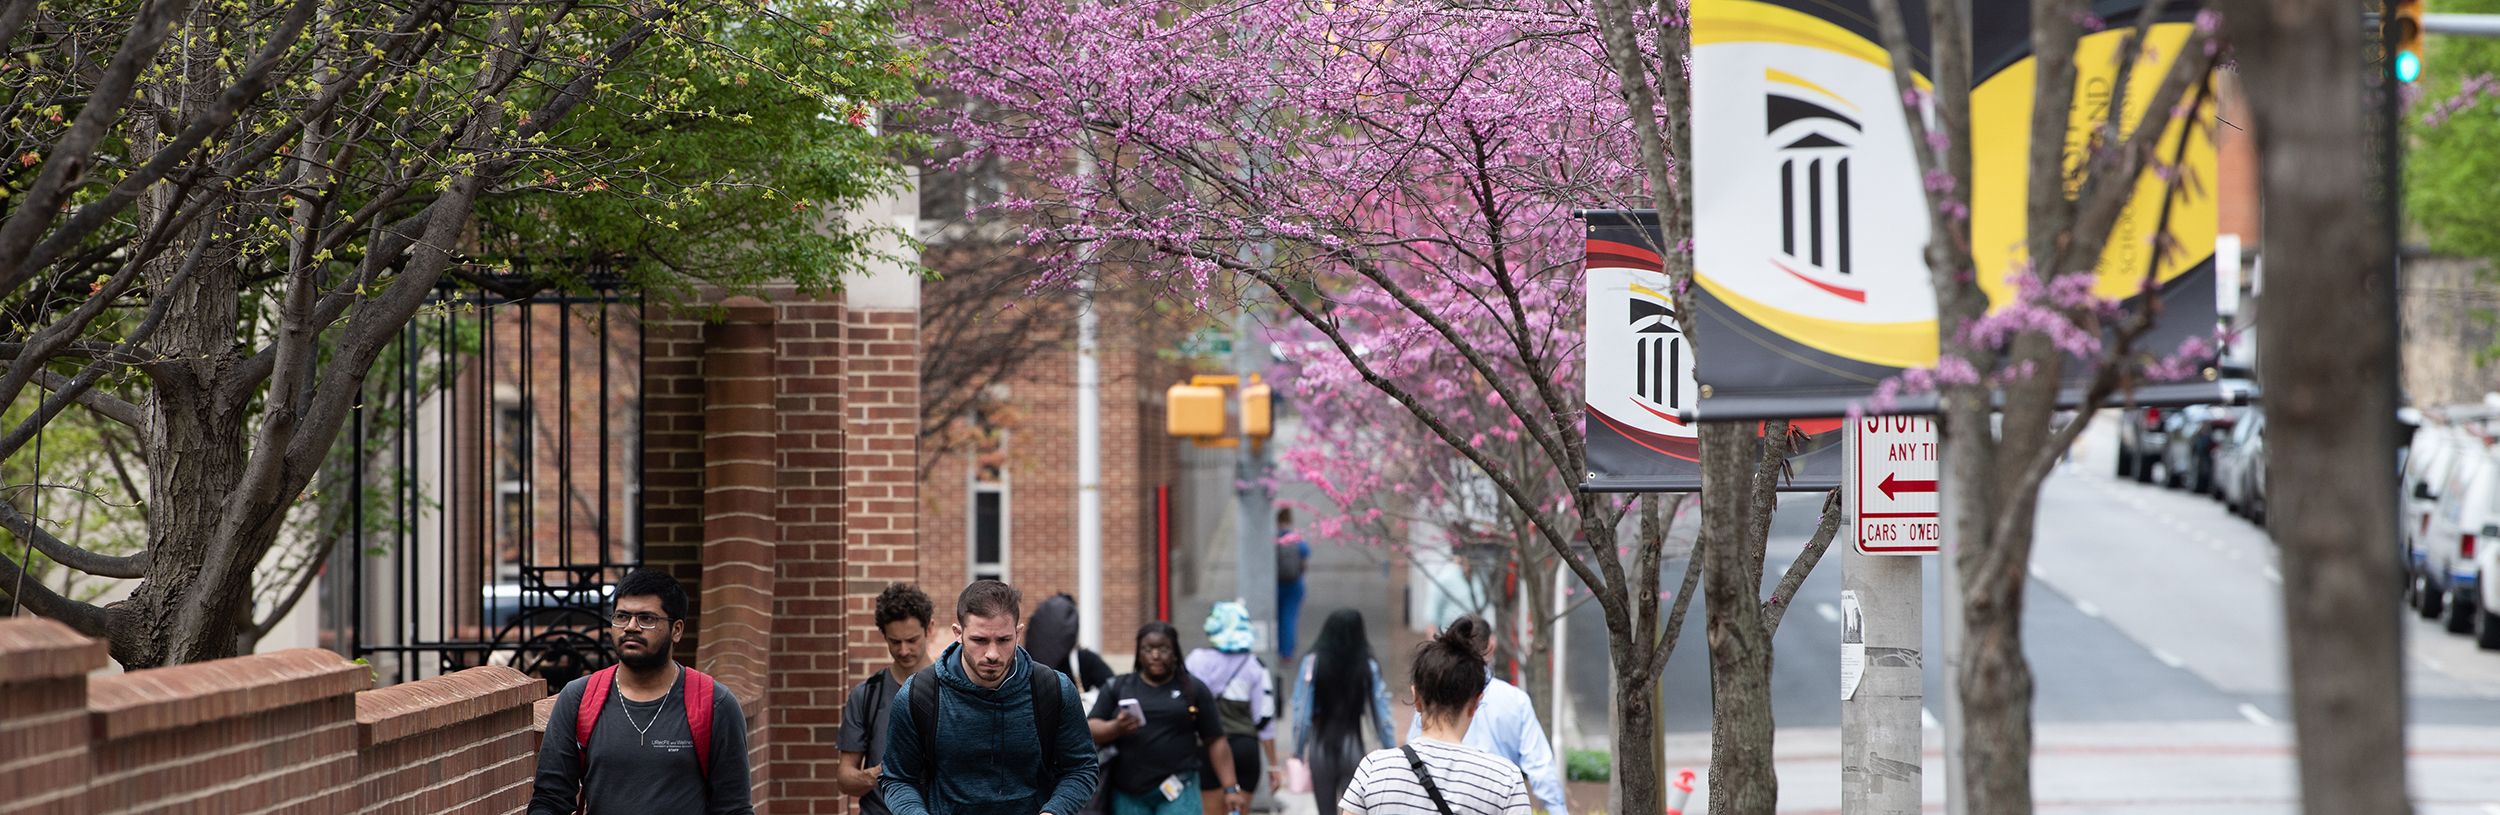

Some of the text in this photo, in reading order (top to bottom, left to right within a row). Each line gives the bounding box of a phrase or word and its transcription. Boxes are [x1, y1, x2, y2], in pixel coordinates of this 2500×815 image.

[2119, 203, 2136, 274] SCHOO
[1888, 443, 1939, 461] ANY TI
[1867, 523, 1940, 541] CARS OWED
